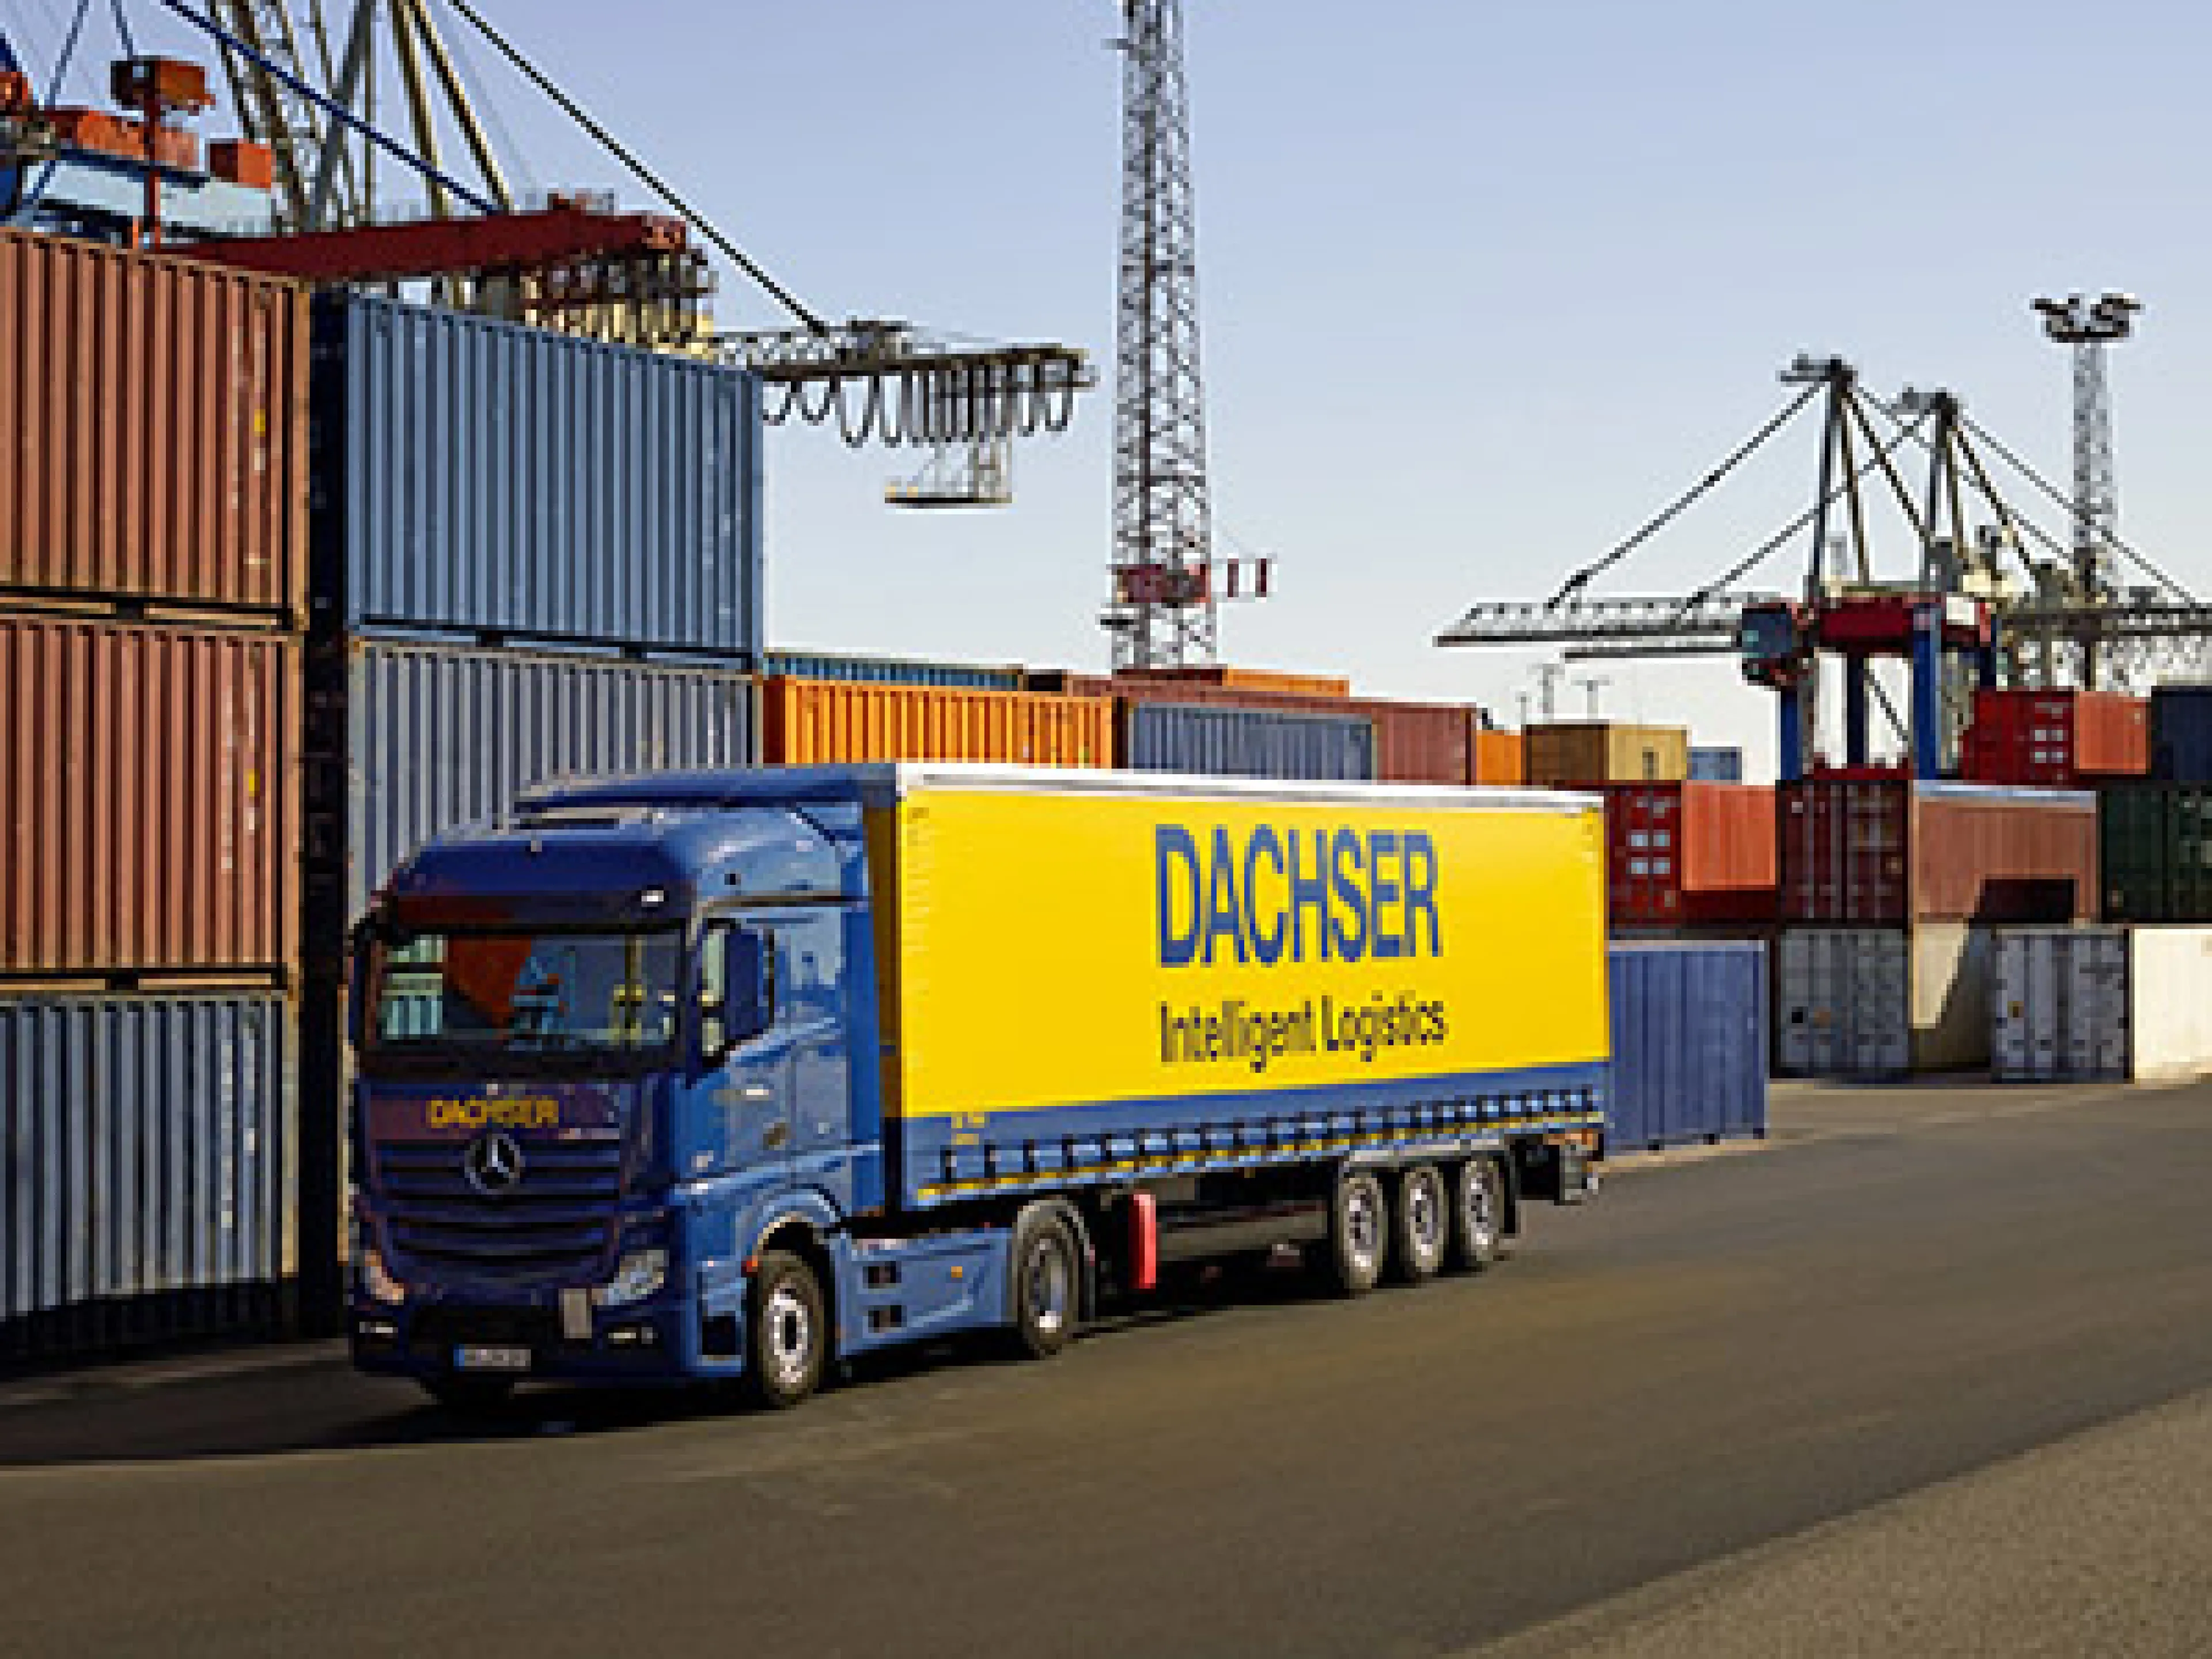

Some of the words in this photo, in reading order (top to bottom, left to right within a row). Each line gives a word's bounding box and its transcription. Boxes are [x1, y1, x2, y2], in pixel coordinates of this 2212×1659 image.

[1156, 824, 1442, 967] DACHSER
[1161, 1001, 1317, 1072] Intelligent
[1322, 990, 1449, 1062] Logistics
[426, 1098, 559, 1128] DACHSER
